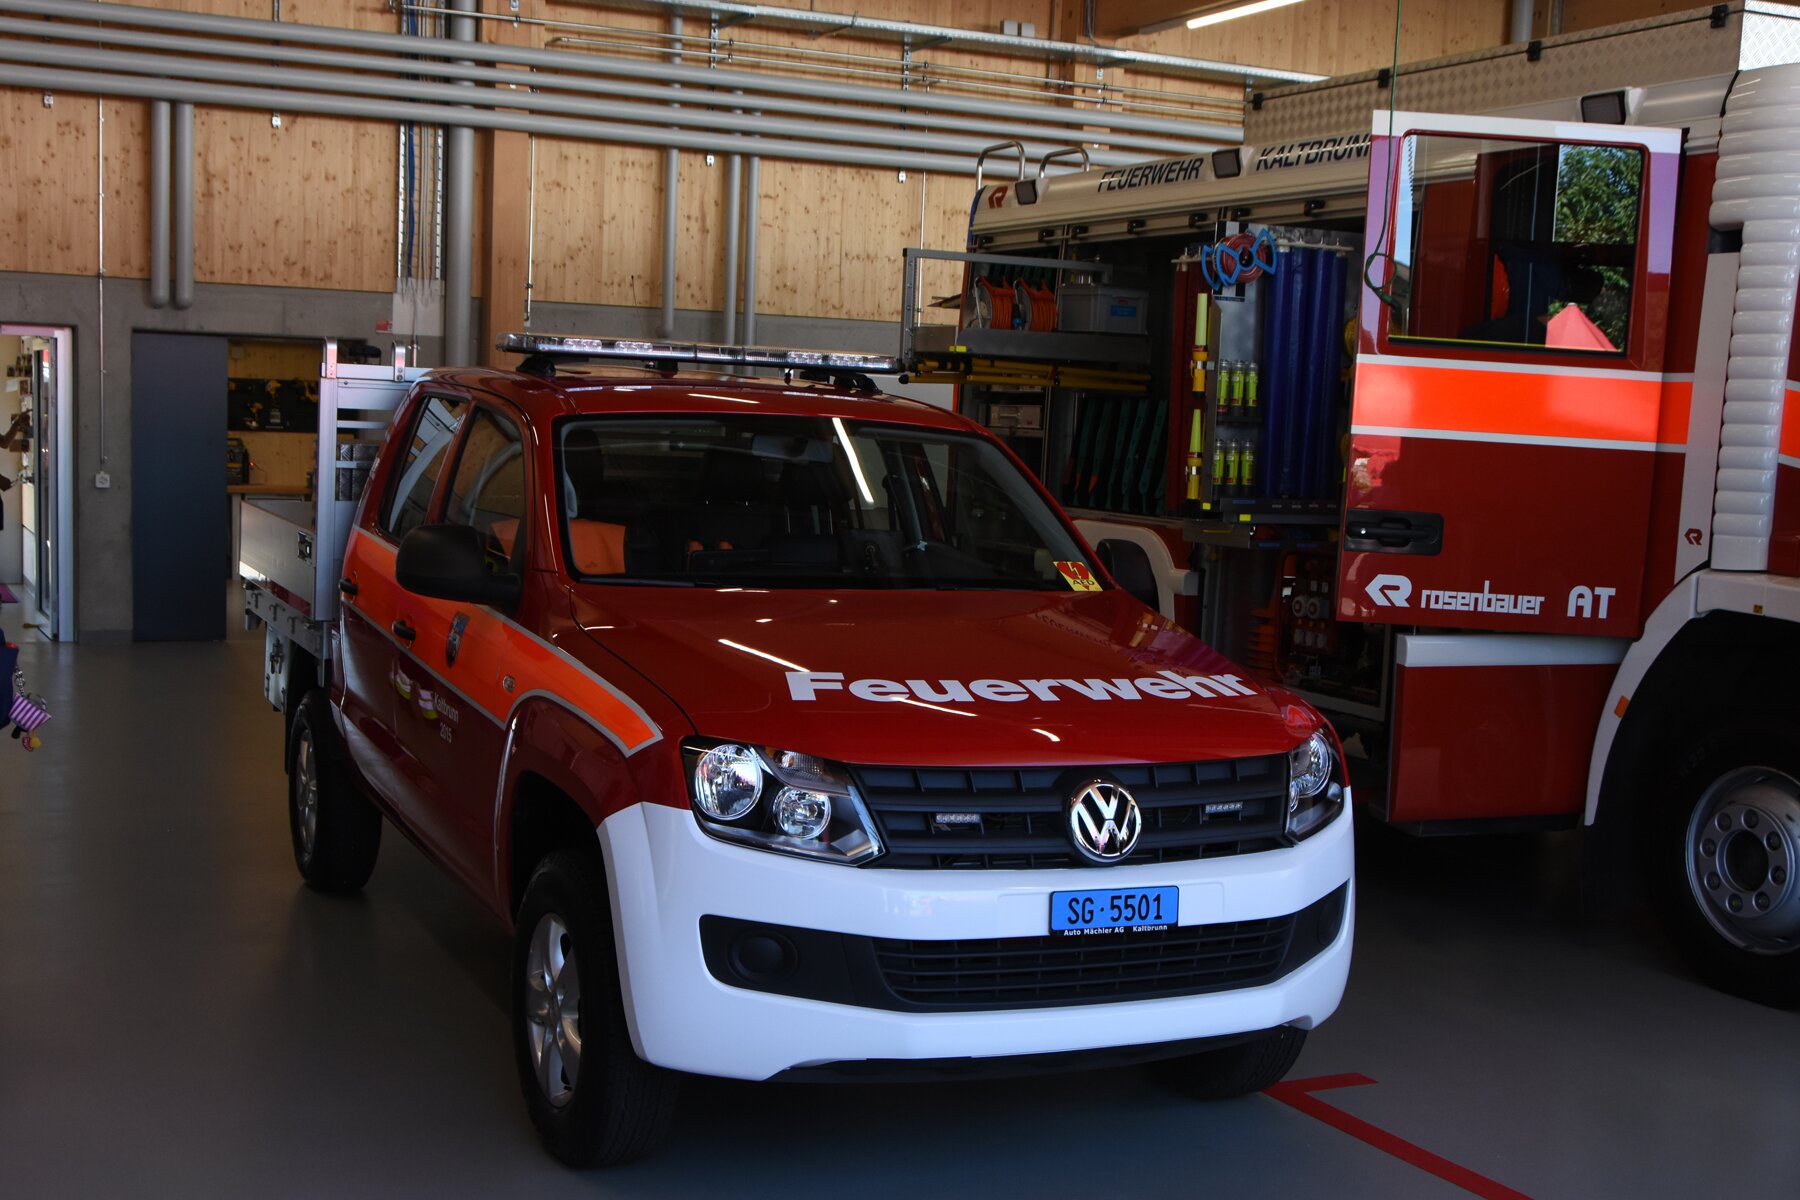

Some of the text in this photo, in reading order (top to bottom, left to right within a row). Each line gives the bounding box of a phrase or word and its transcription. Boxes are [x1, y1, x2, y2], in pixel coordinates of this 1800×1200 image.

[1097, 133, 1372, 193] FEUERWEHR KALTBRUN
[1421, 579, 1546, 616] rosenbauer
[1566, 585, 1617, 620] AT
[784, 670, 1259, 702] Feuerwehr
[440, 722, 452, 743] 2015
[1084, 927, 1112, 935] Mächler
